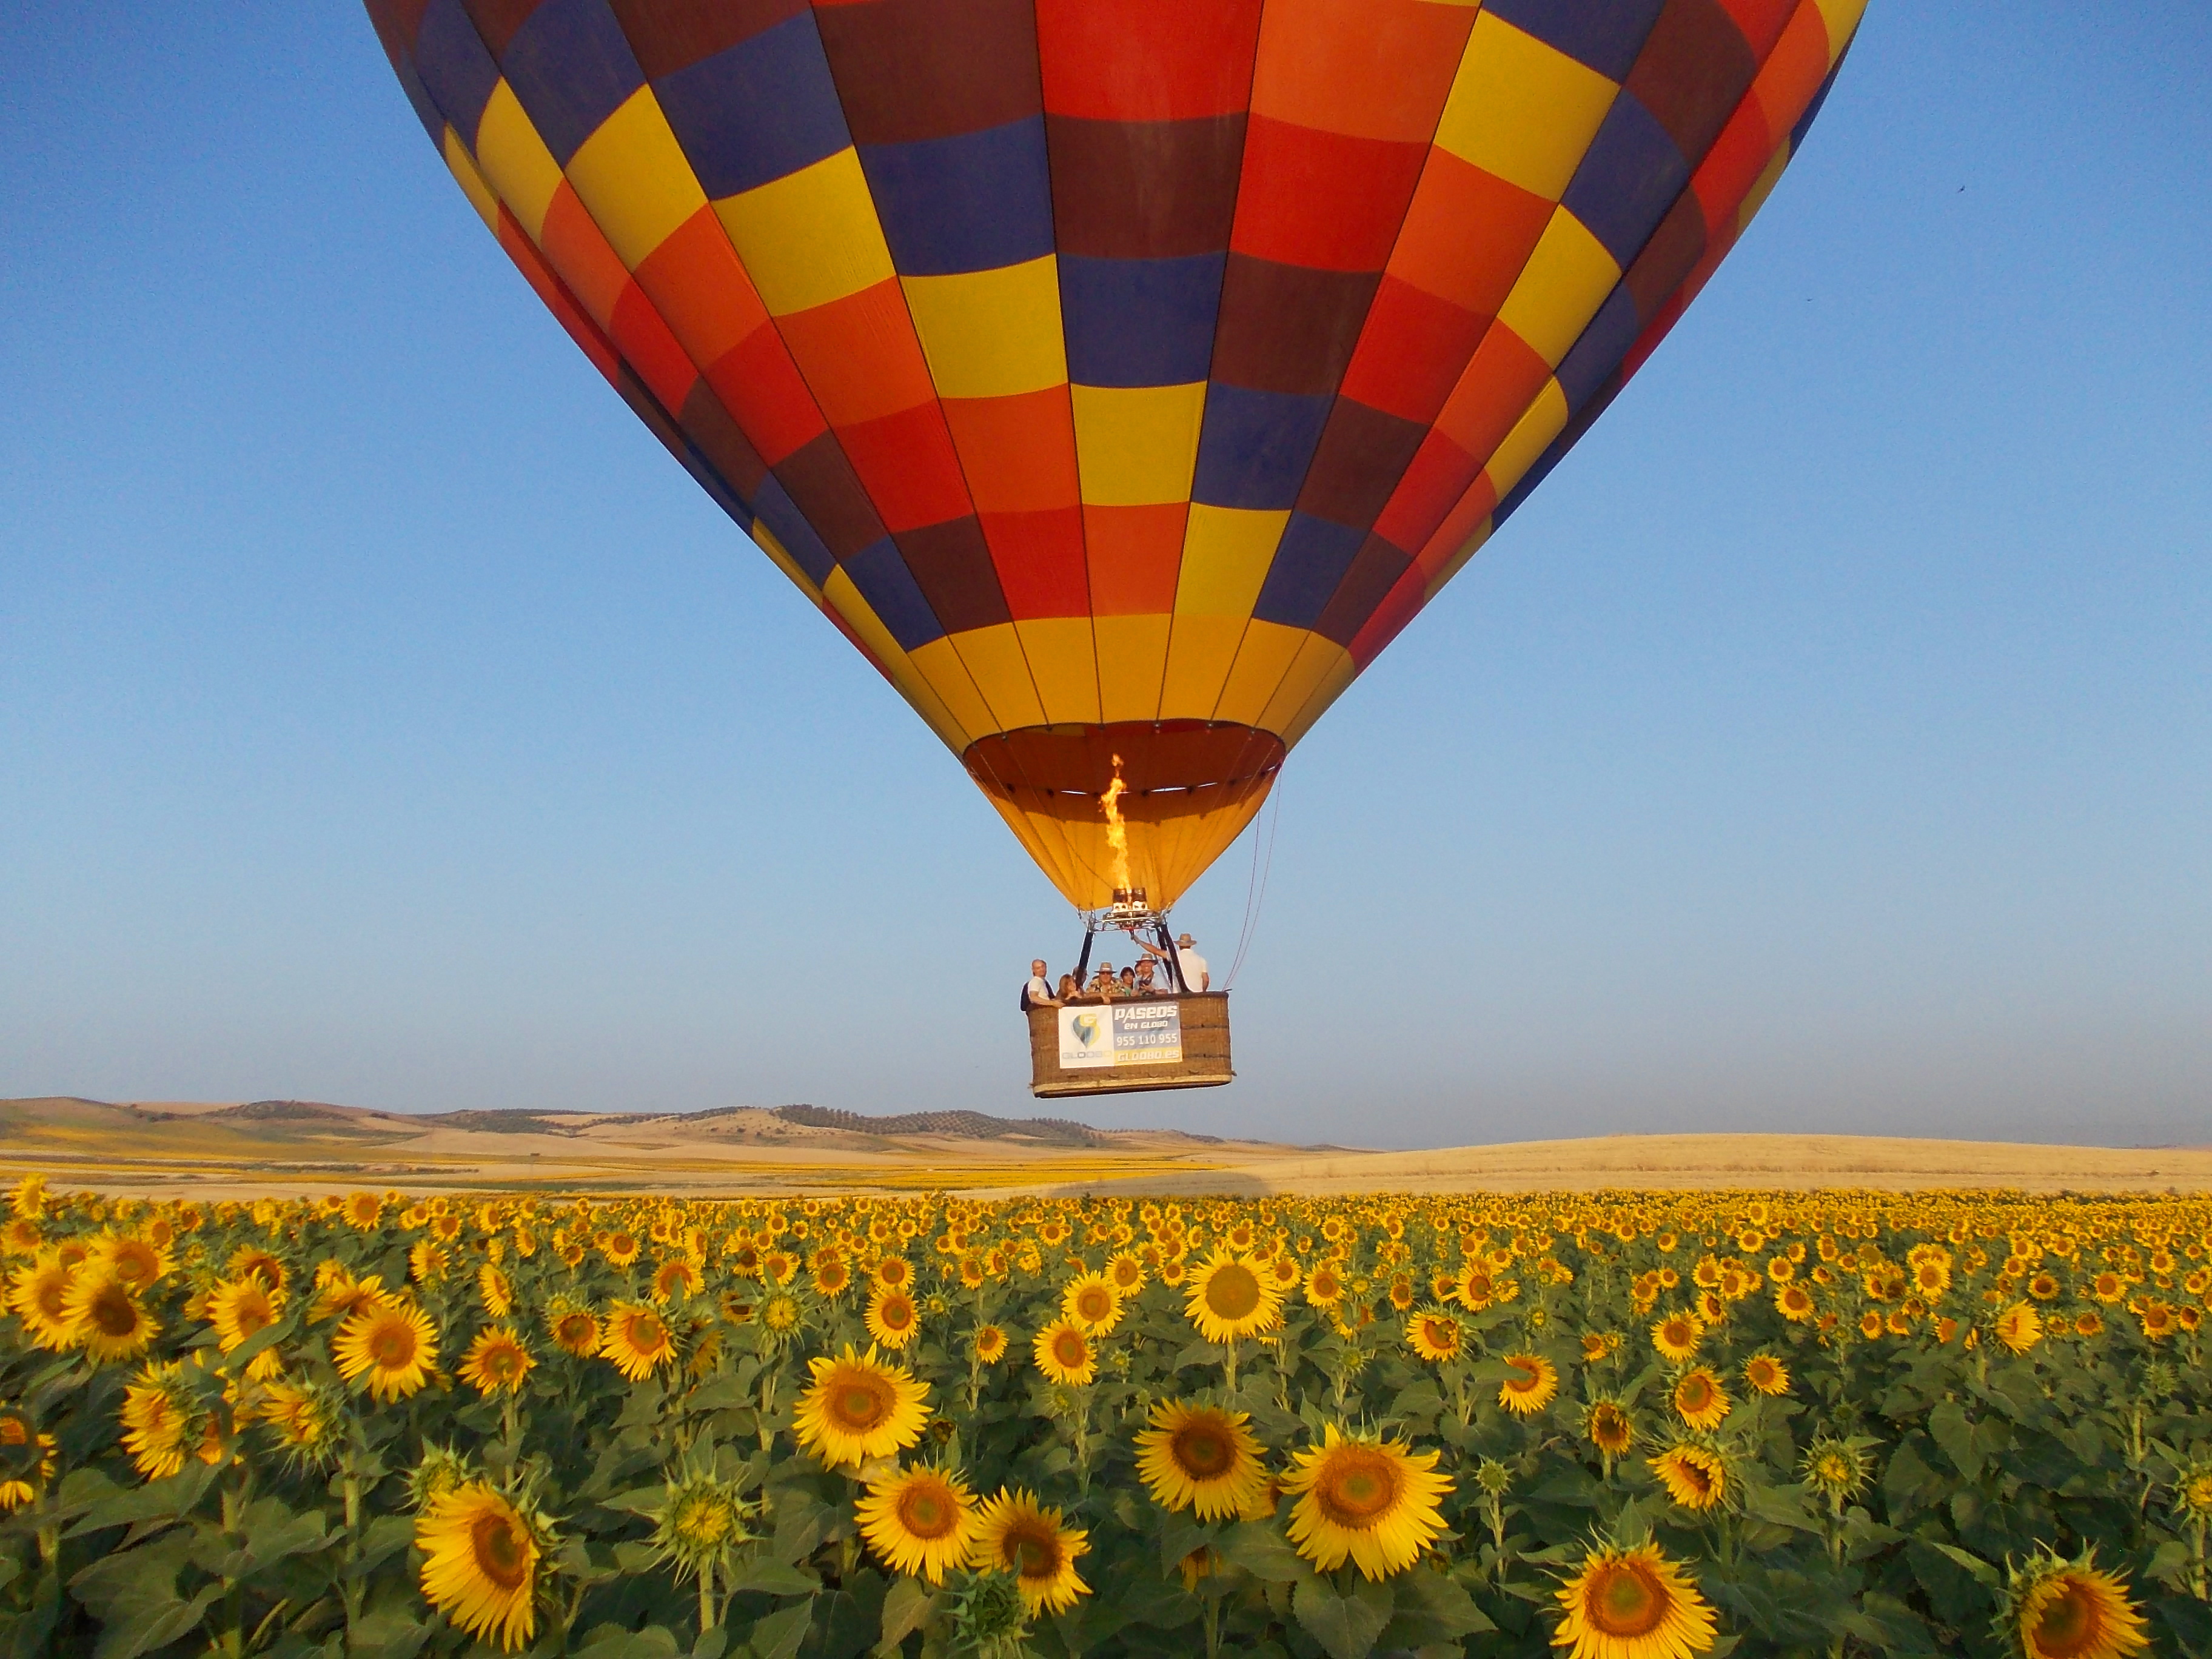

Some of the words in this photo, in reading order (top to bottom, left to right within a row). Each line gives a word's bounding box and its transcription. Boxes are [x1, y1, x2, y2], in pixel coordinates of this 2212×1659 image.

[1117, 1036, 1135, 1047] 955
[1138, 1034, 1156, 1045] 110
[1159, 1033, 1178, 1044] 955
